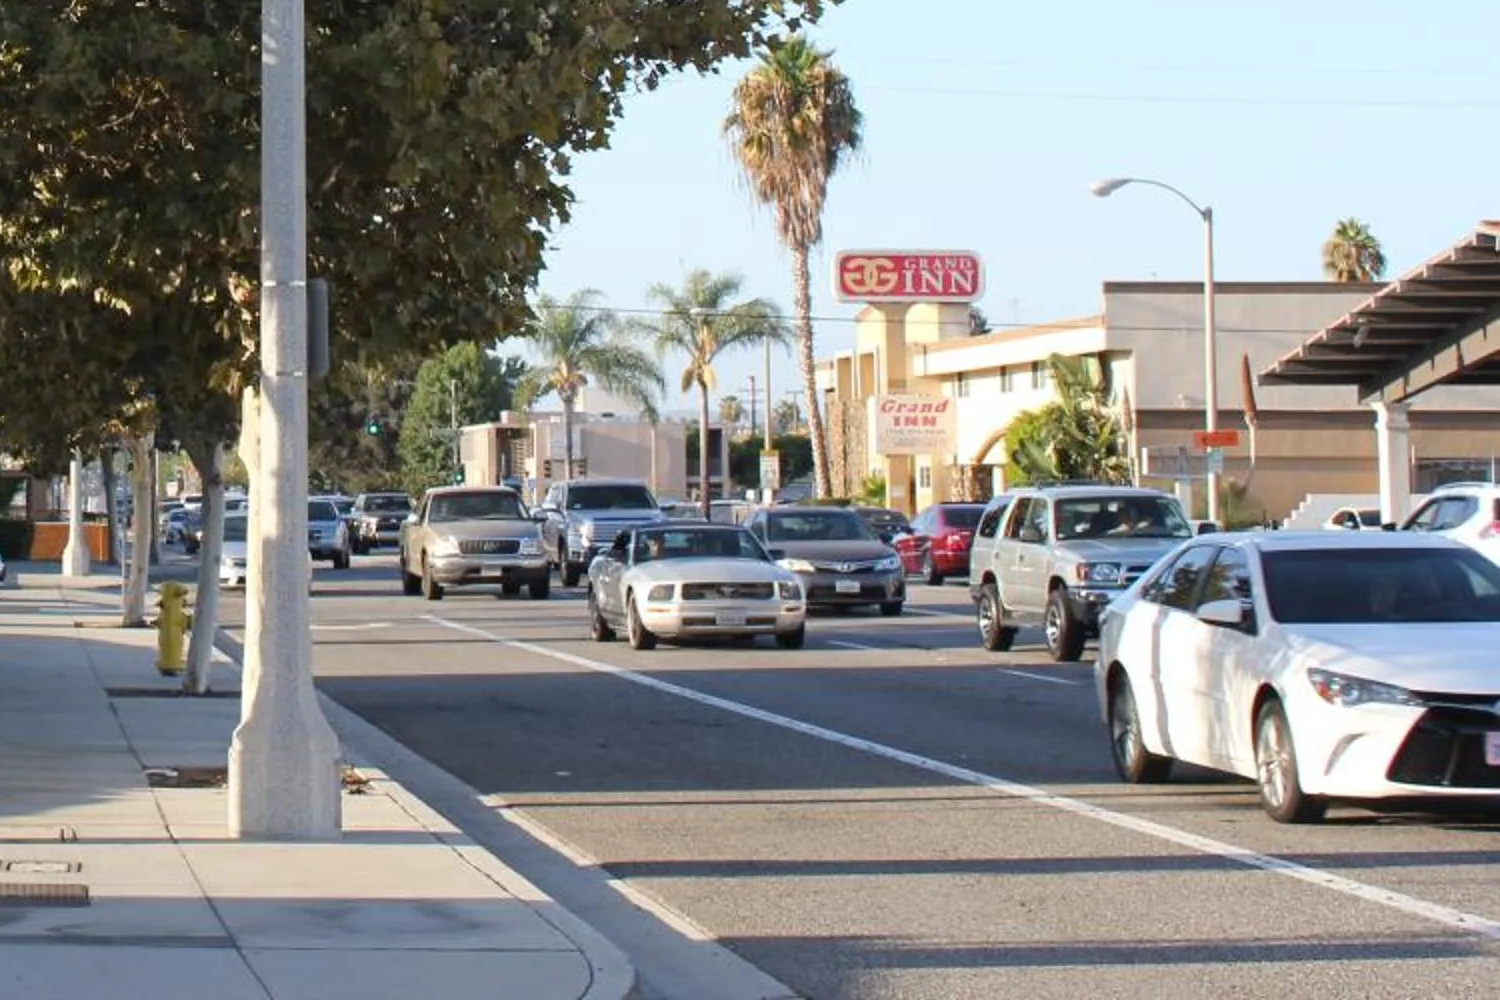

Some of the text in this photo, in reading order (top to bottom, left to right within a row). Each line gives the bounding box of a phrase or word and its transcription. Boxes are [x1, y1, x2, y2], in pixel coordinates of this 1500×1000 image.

[903, 257, 972, 269] GRAND
[902, 269, 975, 293] INN
[881, 399, 949, 413] Grand
[893, 415, 937, 427] INN
